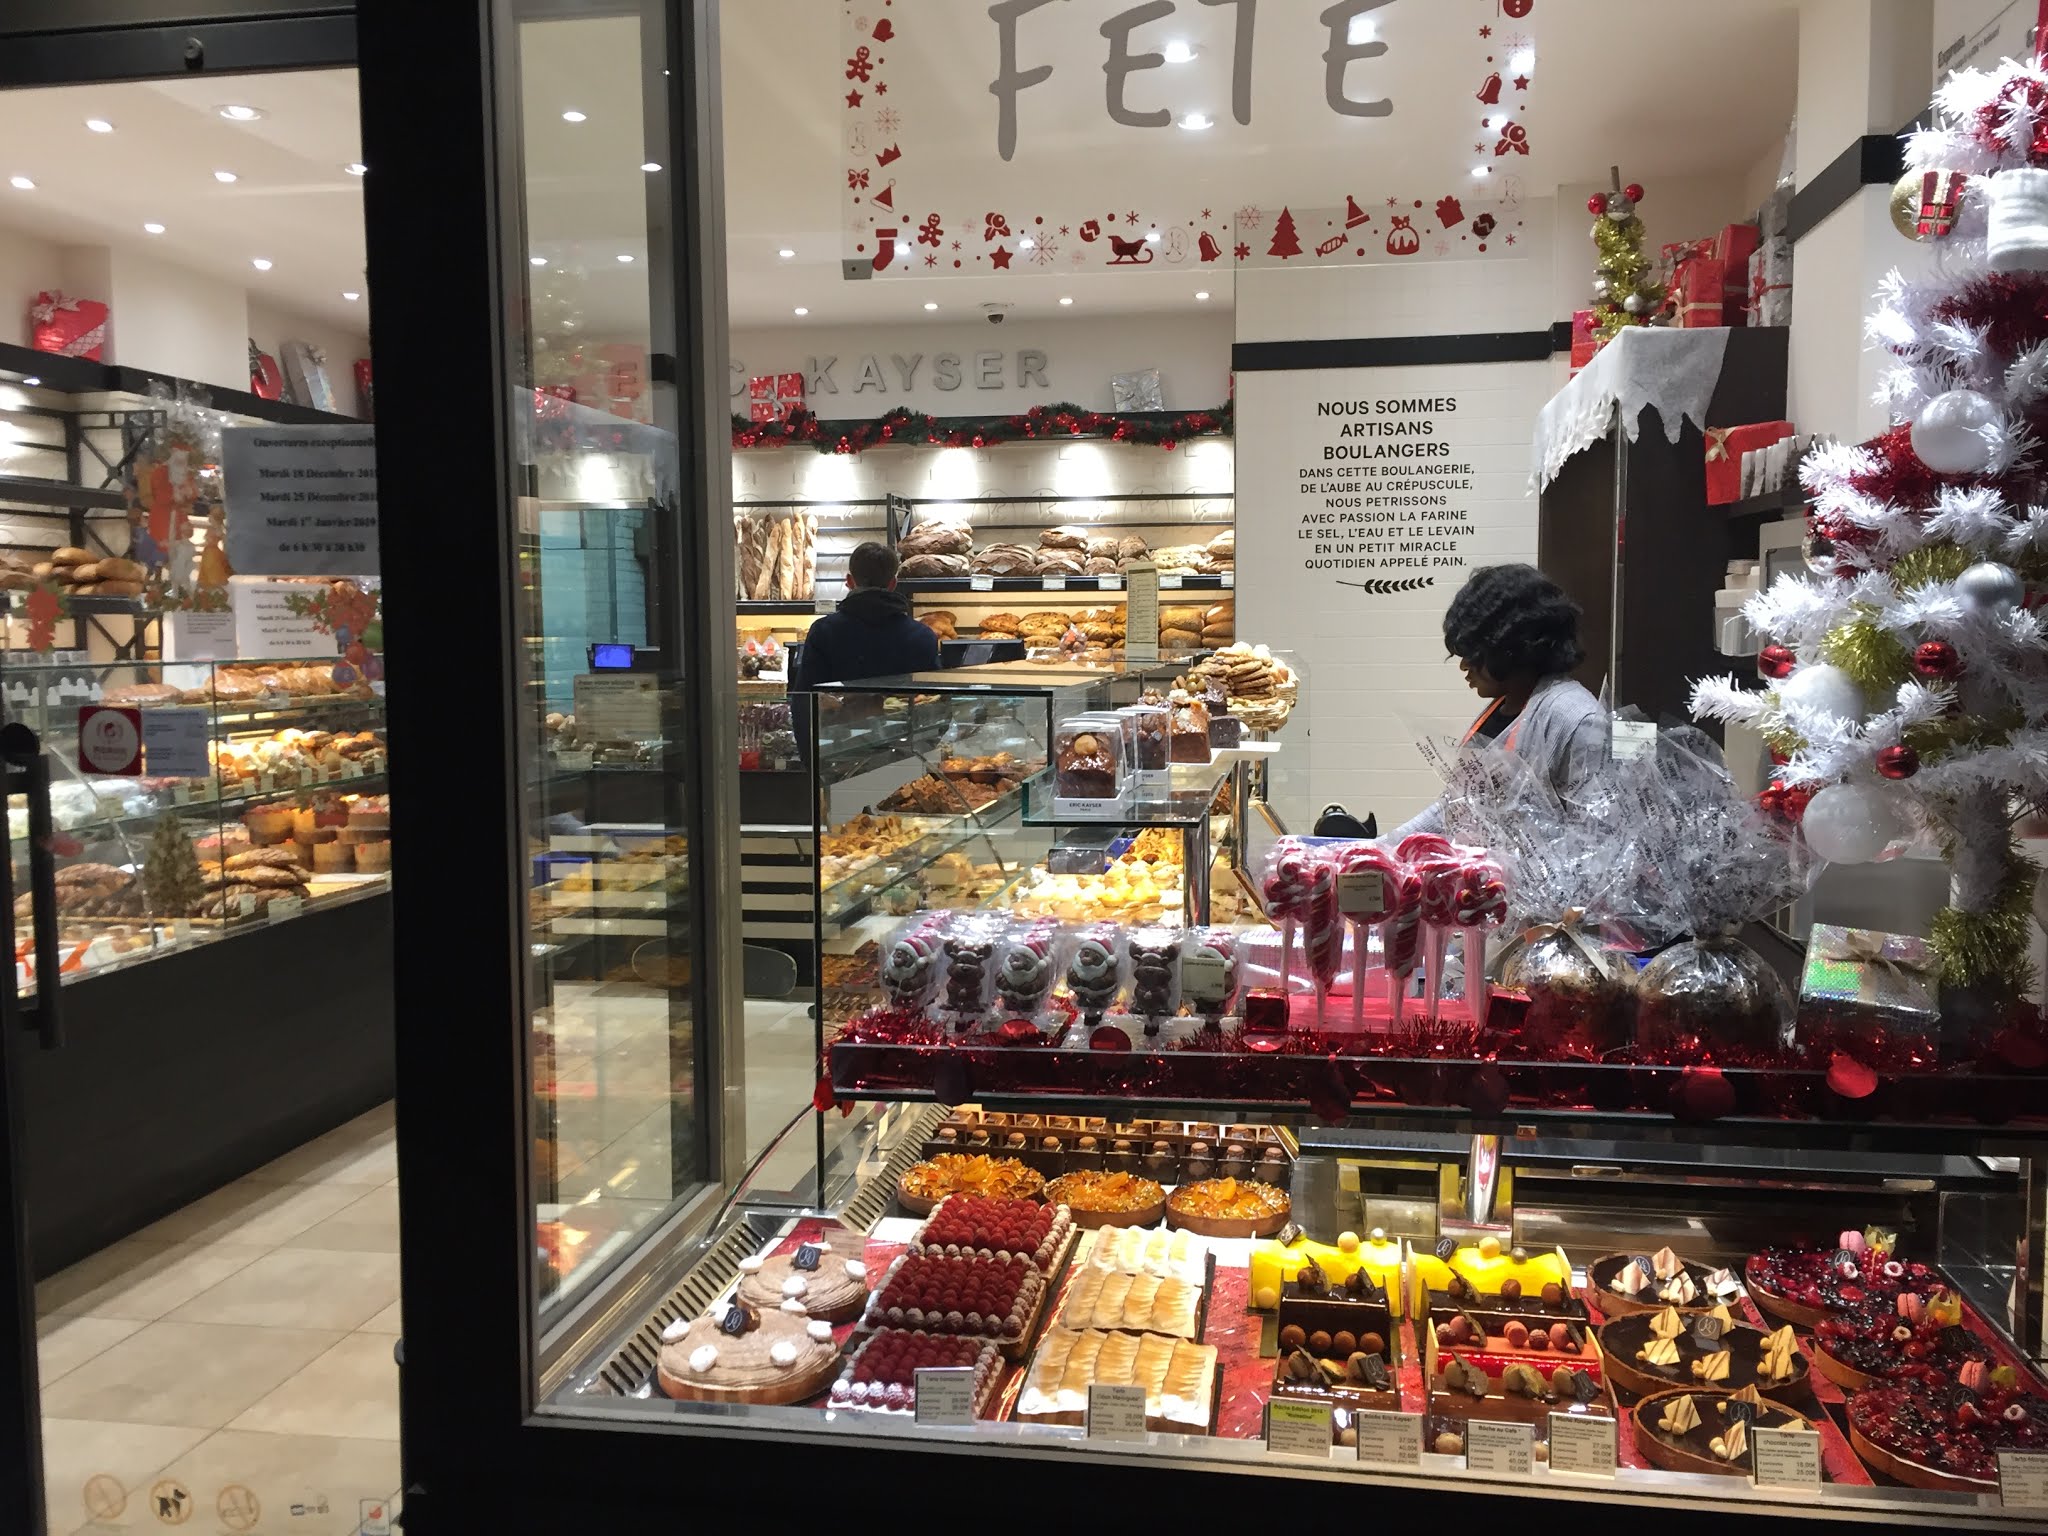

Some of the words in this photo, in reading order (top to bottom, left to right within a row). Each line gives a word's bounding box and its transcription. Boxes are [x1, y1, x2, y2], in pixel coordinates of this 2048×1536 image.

[806, 350, 1049, 394] KAYSER
[1318, 401, 1369, 416] NOUS
[1376, 398, 1457, 414] SOMMES
[1340, 421, 1433, 437] ARTISANS
[311, 437, 376, 449] exceptionnell
[1324, 442, 1450, 460] BOULANGERS
[1300, 468, 1333, 478] DANS
[1337, 466, 1377, 478] CETTE
[1381, 464, 1474, 476] BOULANGERIE,
[1301, 484, 1316, 493] DE
[1366, 482, 1382, 492] AU
[1387, 479, 1473, 490] CRÉPUSCULE,
[1326, 498, 1361, 508] NOUS
[1366, 496, 1447, 507] PETRISSONS
[1302, 514, 1335, 524] AVEC
[1340, 512, 1395, 522] PASSION
[1400, 512, 1416, 521] LA
[1421, 510, 1468, 521] FARINE
[1298, 529, 1312, 539] LE
[1317, 528, 1344, 540] SEL,
[1388, 527, 1404, 537] ET
[1409, 527, 1423, 536] LE
[1428, 526, 1474, 536] LEVAIN
[1315, 544, 1332, 554] EN
[1336, 544, 1354, 553] UN
[1359, 543, 1395, 553] PETIT
[1400, 542, 1457, 552] MIRACLE
[1305, 558, 1375, 570] QUOTIDIEN
[1380, 555, 1428, 567] APPELÉ
[1433, 556, 1467, 567] PAIN.
